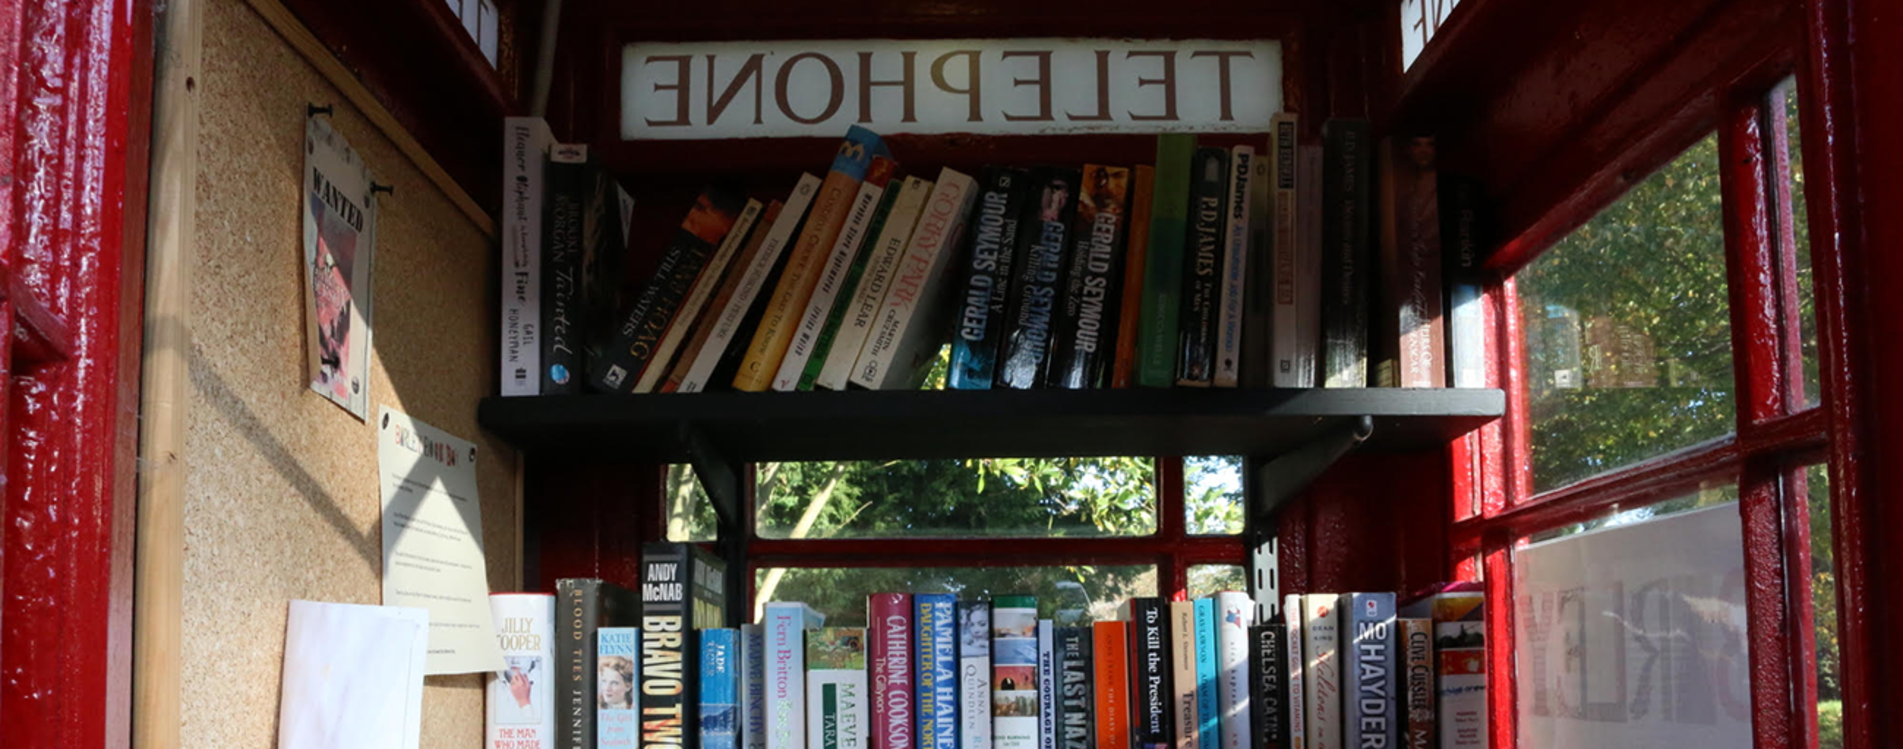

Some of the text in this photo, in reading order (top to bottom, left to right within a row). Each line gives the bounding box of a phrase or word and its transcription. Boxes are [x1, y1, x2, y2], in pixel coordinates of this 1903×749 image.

[515, 126, 529, 171] Eleanor
[312, 166, 364, 233] WANTED
[513, 175, 529, 221] Oliphant
[550, 192, 568, 263] MORGAN
[889, 181, 962, 312] GORKY PARK
[869, 237, 900, 294] EDWARD
[957, 188, 1012, 343] GERALD SEYMOUR
[992, 217, 1018, 313] A Line in the Sand
[1032, 218, 1066, 285] GERALD
[515, 271, 528, 302] Fine
[618, 244, 683, 339] STILL WATERS
[1016, 242, 1045, 328] Killing Ground
[1065, 239, 1089, 318] Holding the Zero
[1073, 211, 1117, 354] GERALD SEYMOUR
[551, 265, 573, 354] Tainted
[626, 292, 679, 363] HOAG
[854, 293, 876, 329] LEAR
[869, 307, 897, 357] CRUZ SMITH
[507, 307, 519, 362] HONEYMAN
[522, 323, 533, 345] GAIL
[880, 319, 900, 351] MARTIN
[1420, 318, 1431, 350] HEIRS
[1419, 351, 1432, 367] OF
[642, 584, 683, 602] McNAB
[648, 563, 678, 581] ANDY
[502, 617, 533, 634] JILLY
[572, 589, 582, 640] BLOOD
[776, 614, 791, 646] Fern
[918, 602, 934, 671] DAUGHTER
[1359, 622, 1386, 640] MO
[496, 634, 541, 651] OOPER
[600, 633, 632, 643] KATIE
[600, 644, 633, 654] FLYNN
[642, 615, 682, 696] BRAVO
[715, 643, 724, 674] JADE
[747, 633, 763, 679] MAEVE
[886, 614, 908, 686] CATHERINE
[932, 600, 955, 683] PAMELA
[1064, 636, 1079, 658] THE
[1259, 630, 1277, 692] CHELSEA
[1290, 624, 1298, 655] POCKET
[1314, 634, 1333, 642] KING
[572, 648, 582, 682] TIES
[776, 648, 791, 698] Britton
[874, 655, 886, 713] The Gillyvors
[920, 672, 933, 688] OF
[1042, 651, 1050, 676] THE
[1061, 659, 1086, 709] LAST
[1145, 606, 1163, 734] To Kill the President
[1291, 656, 1299, 681] GUIDE
[1313, 645, 1336, 721] Skeletons
[747, 682, 764, 735] BINCHY
[921, 690, 934, 716] THE
[963, 663, 978, 730] QUINDLEN
[976, 678, 987, 716] ANNA
[1042, 678, 1052, 735] COURAGE
[1292, 684, 1300, 694] TO
[1358, 643, 1387, 749] HAYDER
[499, 728, 537, 738] THE MAN
[616, 713, 632, 724] Girl
[823, 712, 836, 747] TARA
[838, 682, 857, 748] MAEVE
[1107, 706, 1115, 731] DIARY
[1180, 690, 1198, 748] Treasure
[1292, 696, 1301, 733] VITAMINS
[494, 740, 541, 749] WHO MADE
[1109, 733, 1115, 745] OF
